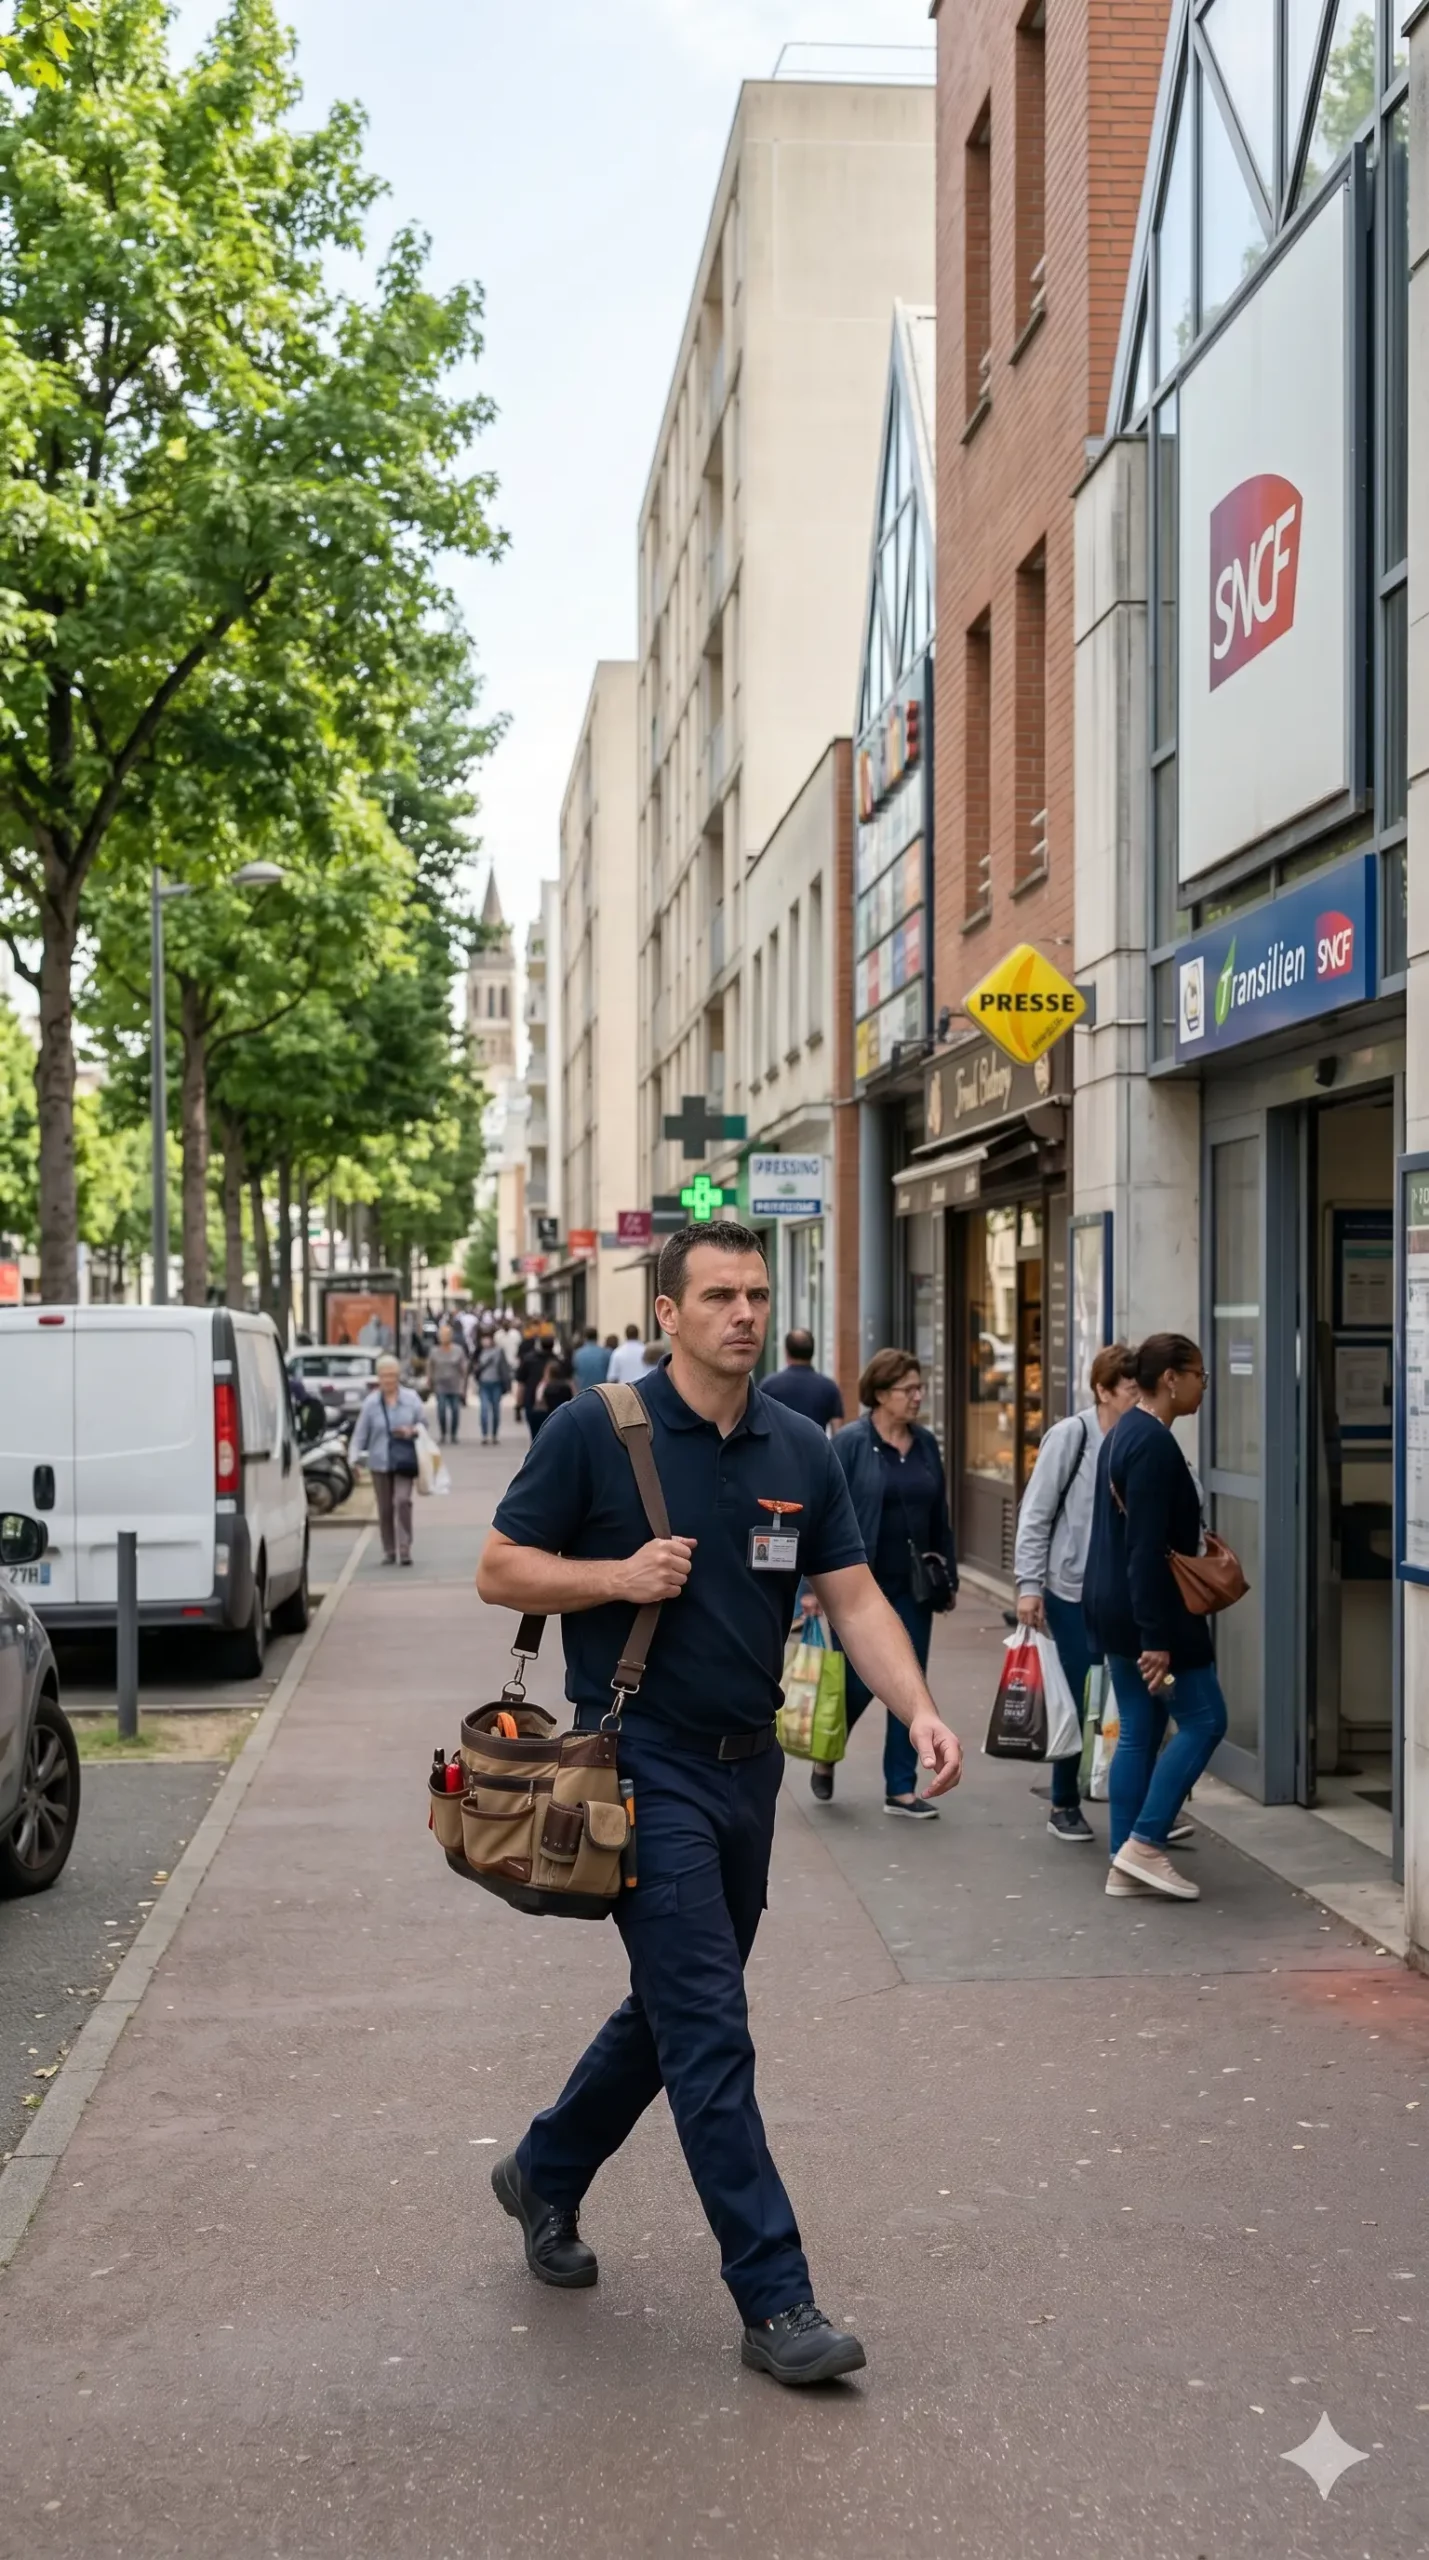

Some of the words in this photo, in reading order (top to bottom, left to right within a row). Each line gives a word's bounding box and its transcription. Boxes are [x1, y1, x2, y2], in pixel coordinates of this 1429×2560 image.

[1213, 503, 1296, 660] SNCF
[1317, 927, 1352, 975] SNCF
[979, 993, 1075, 1012] PRESSE
[1220, 940, 1306, 1017] Transilien
[753, 1158, 819, 1176] PRESSING
